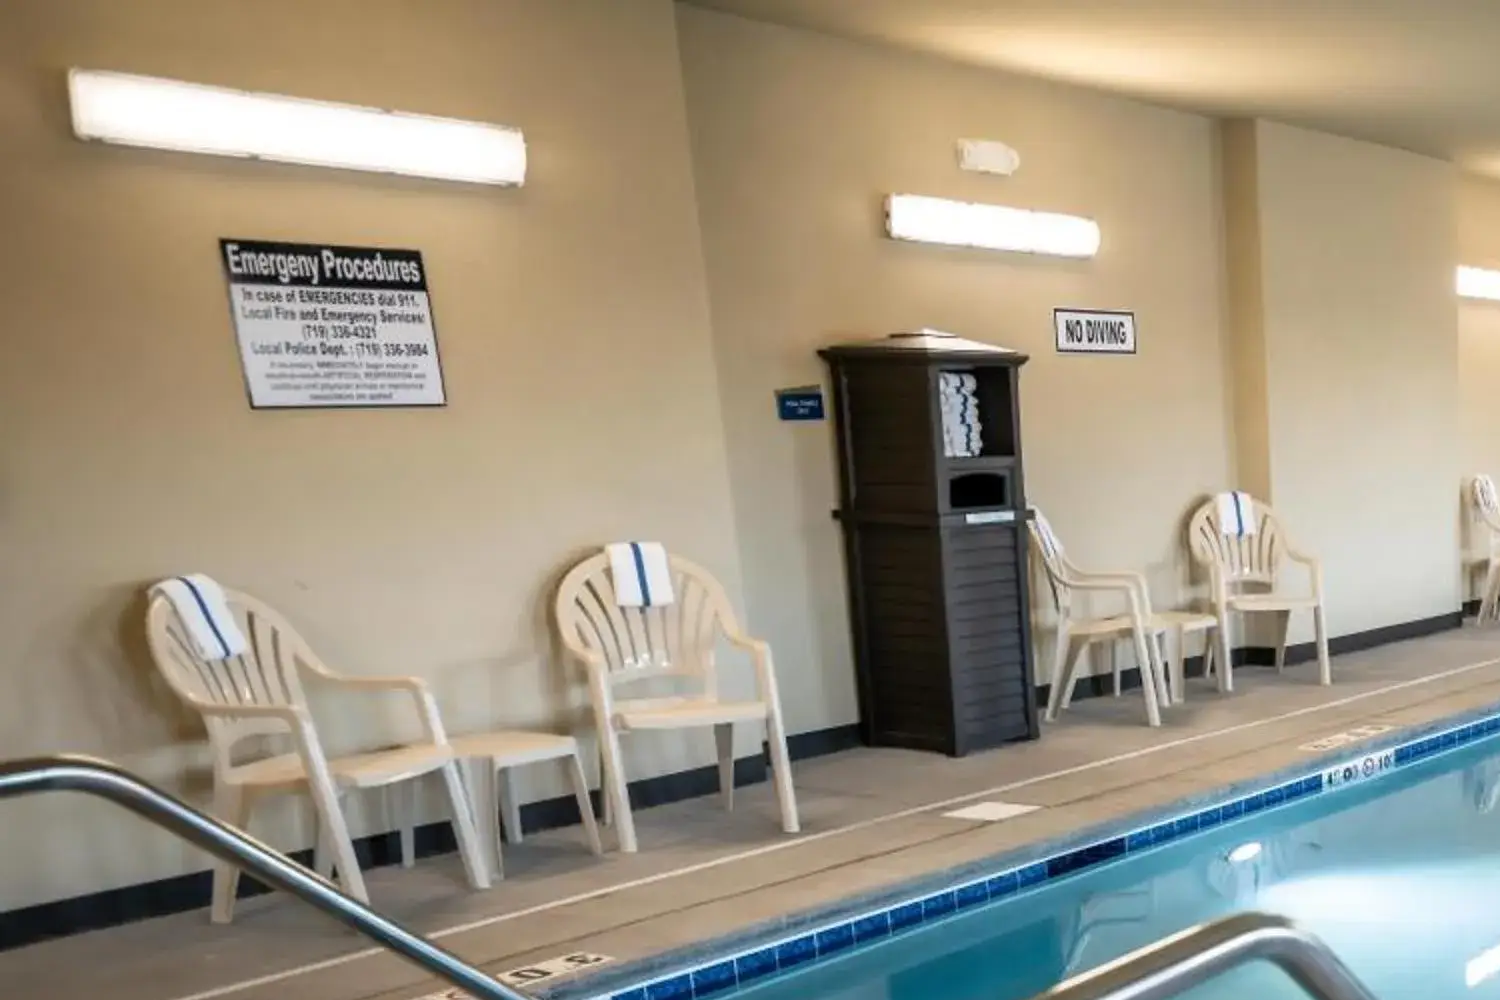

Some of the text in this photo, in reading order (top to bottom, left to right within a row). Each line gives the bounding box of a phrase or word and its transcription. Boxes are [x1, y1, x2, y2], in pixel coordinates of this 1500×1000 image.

[225, 243, 421, 284] Emergeny Procedures
[299, 289, 375, 306] EMERGENCIES
[241, 304, 272, 320] Local
[274, 306, 296, 320] Fire
[300, 307, 318, 321] and
[320, 307, 377, 326] Emergency
[1065, 319, 1127, 345] NO DIVING
[250, 341, 282, 355] Local
[285, 341, 317, 355] Police
